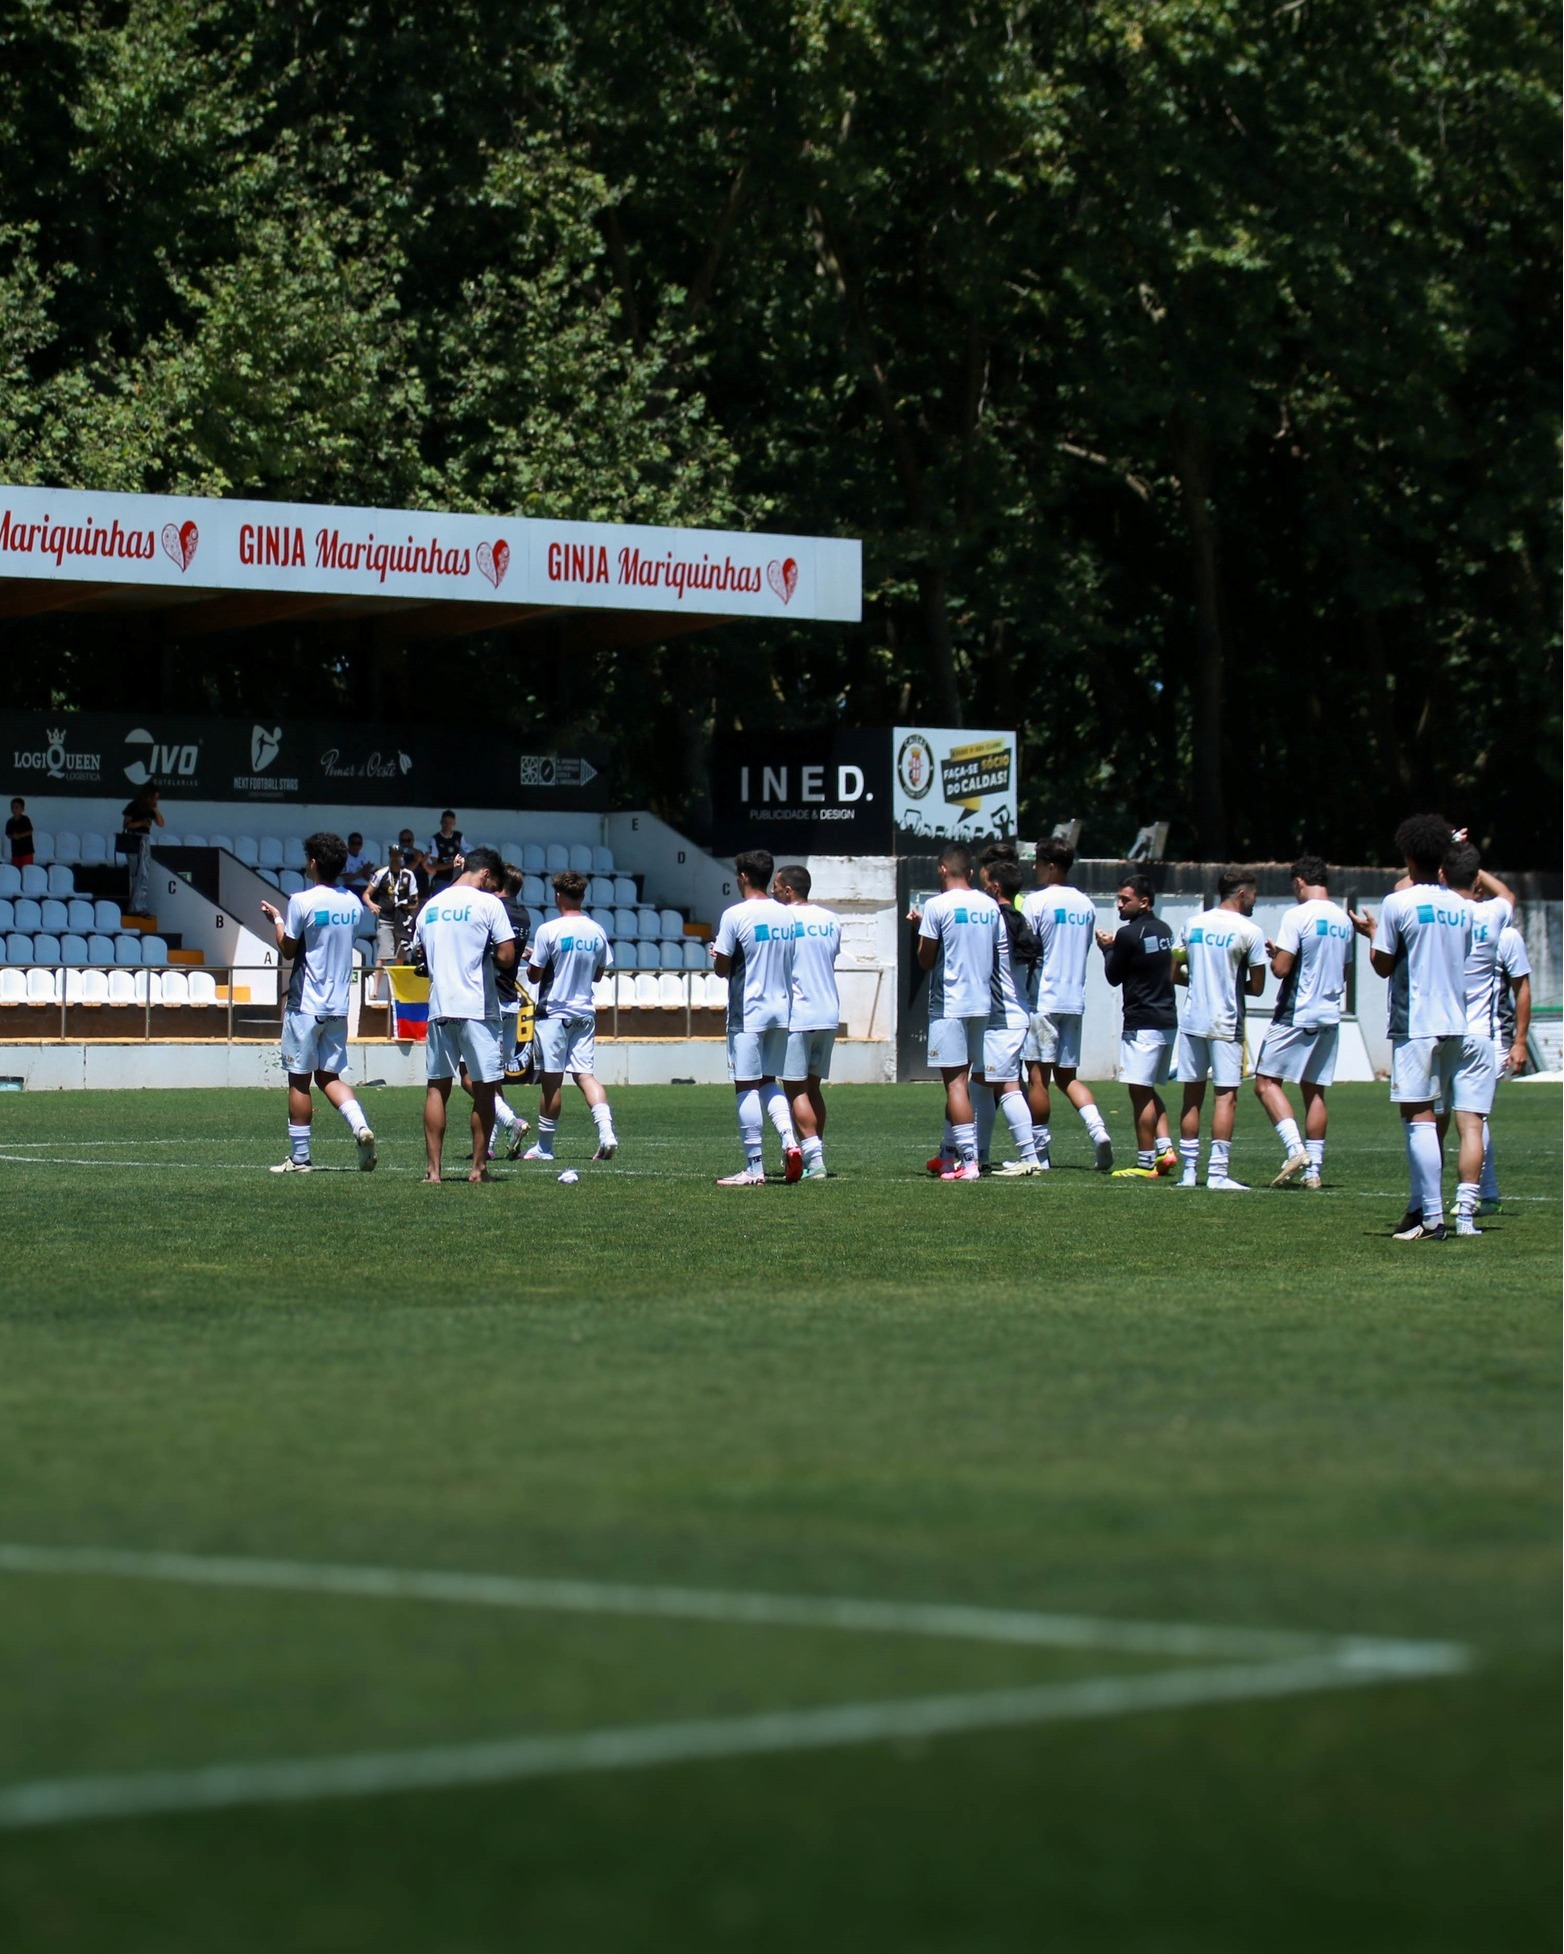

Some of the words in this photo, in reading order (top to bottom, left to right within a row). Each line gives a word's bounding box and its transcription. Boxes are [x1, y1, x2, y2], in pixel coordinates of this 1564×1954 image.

[239, 524, 306, 567] GINJA
[315, 528, 470, 583] Mariquinhas
[548, 541, 610, 584] GINJA
[616, 546, 762, 599] Mariquinhas
[149, 744, 199, 776] IVO
[943, 763, 979, 781] FAÇA-SE
[981, 755, 1010, 771] SÓCIO
[233, 777, 249, 790] NEXT
[249, 777, 279, 791] FOOTBALL
[278, 778, 299, 791] STARS
[946, 783, 961, 796] DO
[961, 770, 1009, 793] CALDAS!
[750, 809, 810, 820] PUBLICIDADE
[811, 809, 818, 820] &
[820, 808, 855, 820] DESIGN
[631, 819, 638, 831] E
[677, 851, 685, 865] D
[168, 880, 176, 894] C
[722, 882, 730, 896] C
[331, 908, 356, 925] cuf
[442, 905, 473, 922] cuf
[970, 908, 995, 925] cuf
[1436, 909, 1466, 928] cuf
[215, 915, 224, 929] B
[807, 922, 834, 937] cuf
[771, 923, 795, 941] cuf
[1205, 932, 1236, 948] cuf
[575, 937, 599, 952] cuf
[264, 951, 272, 965] A
